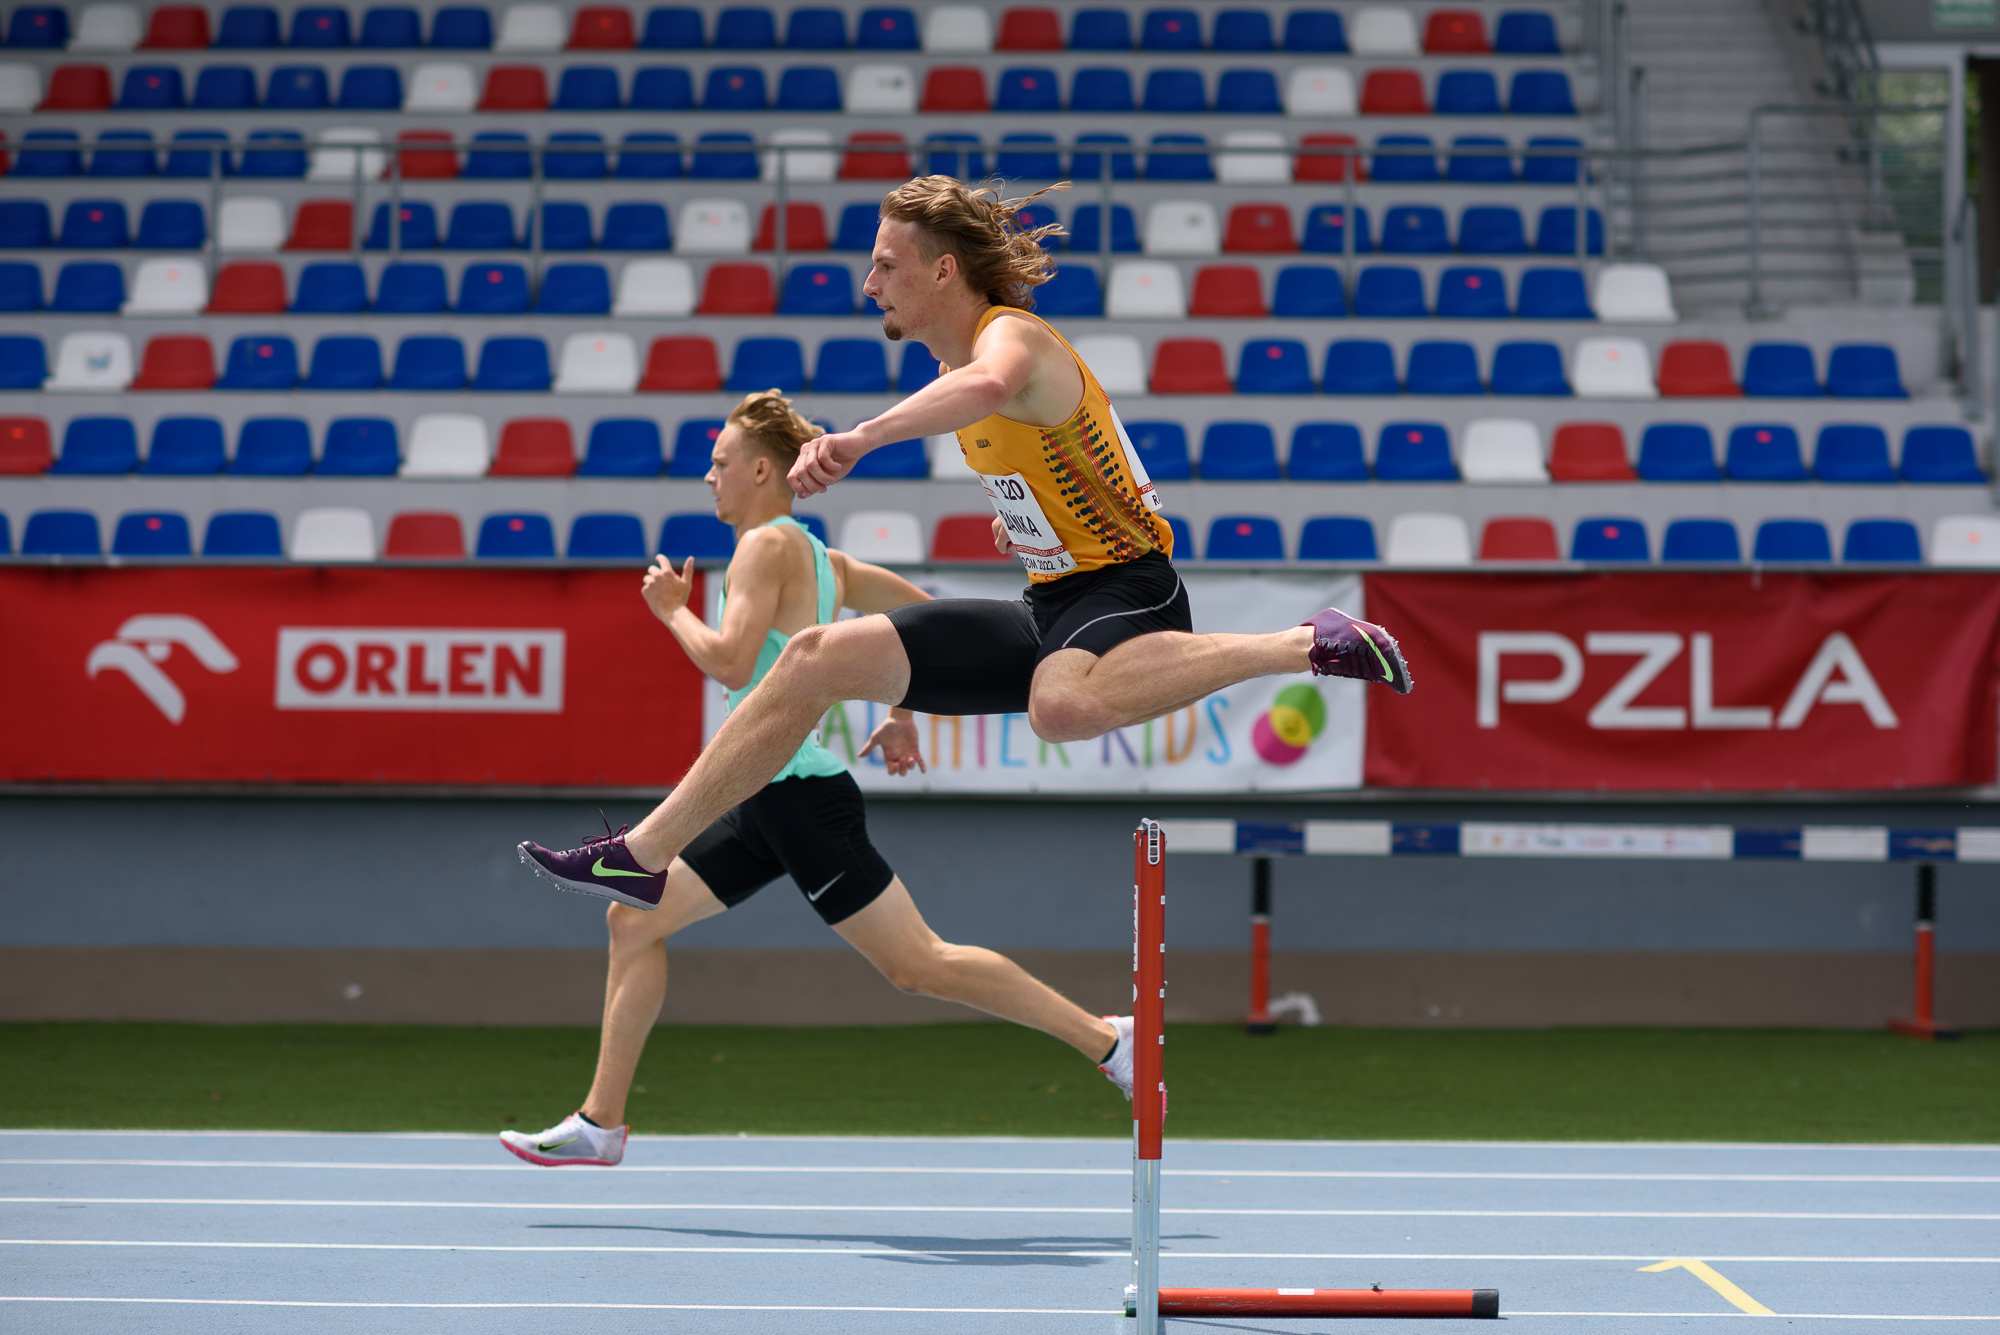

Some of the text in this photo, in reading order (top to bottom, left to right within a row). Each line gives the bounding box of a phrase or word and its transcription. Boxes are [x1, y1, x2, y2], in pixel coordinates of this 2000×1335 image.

[994, 478, 1026, 501] 120
[1037, 559, 1056, 571] 2022
[294, 640, 545, 697] ORLEN
[1476, 631, 1900, 730] PZLA
